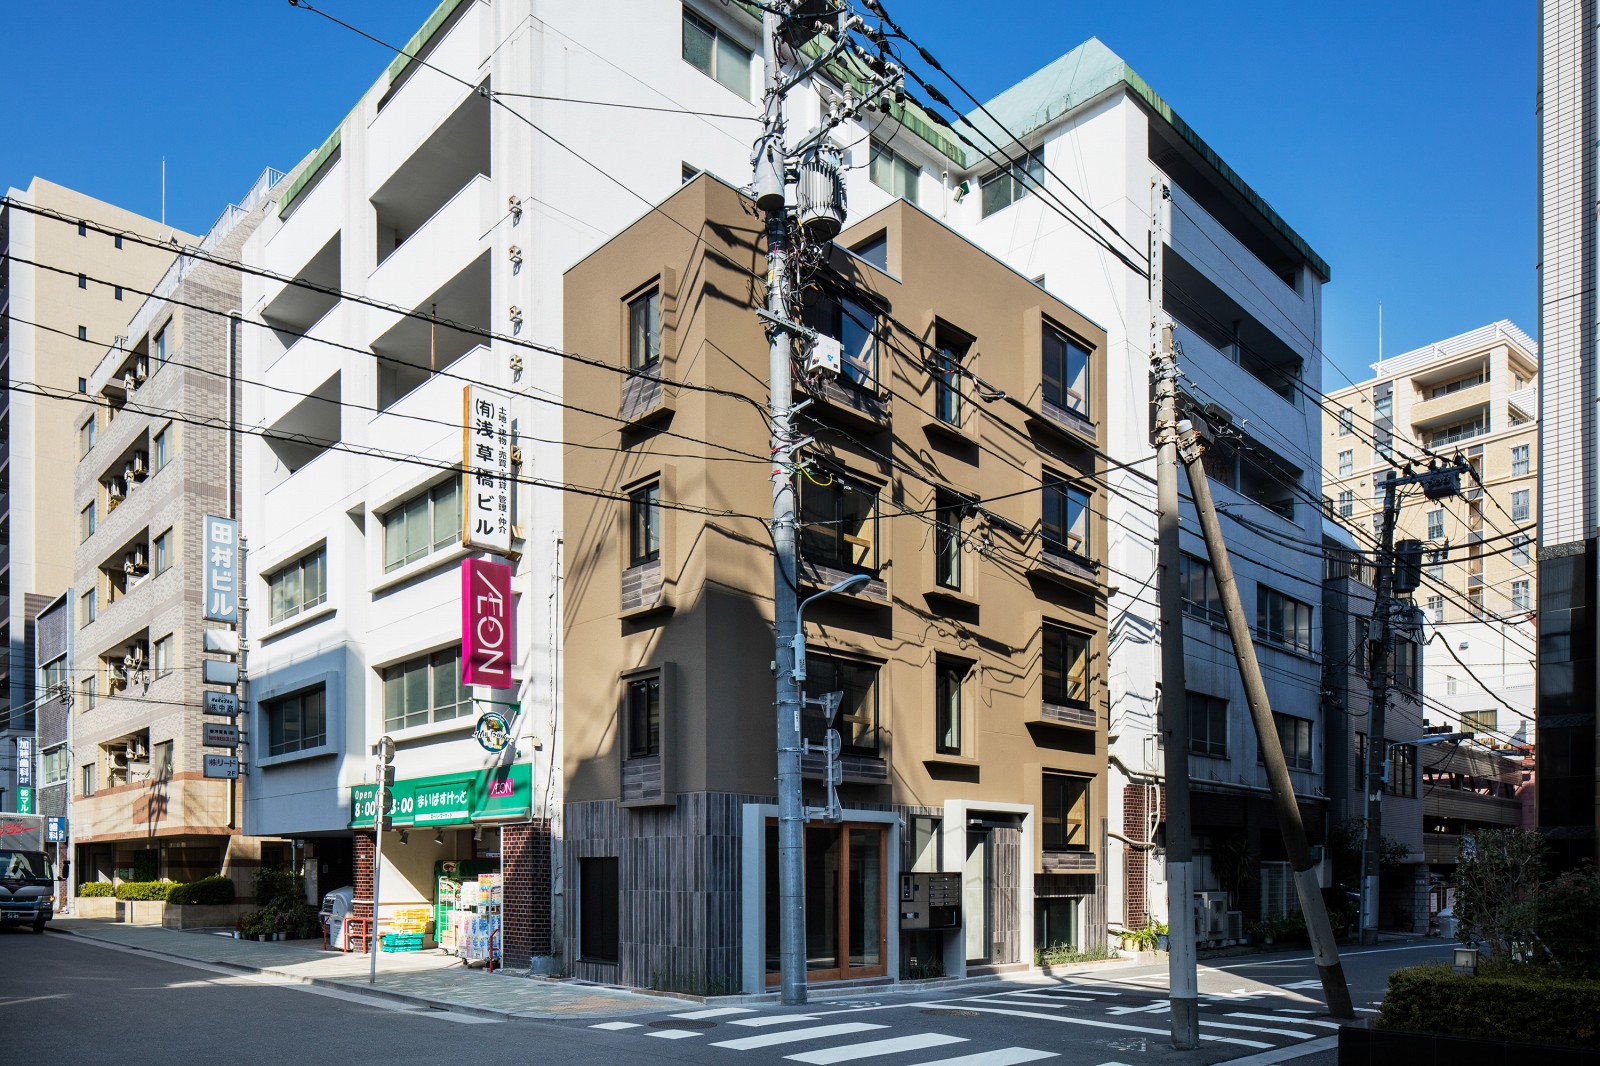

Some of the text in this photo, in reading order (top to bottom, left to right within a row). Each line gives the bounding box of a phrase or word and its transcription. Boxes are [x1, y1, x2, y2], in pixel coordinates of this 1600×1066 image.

[475, 398, 495, 536] (有)浅草橋ビル
[210, 521, 234, 616] 田村ビル
[354, 790, 373, 801] Open
[417, 790, 468, 808] まいばすけっと
[354, 801, 376, 818] 8:00
